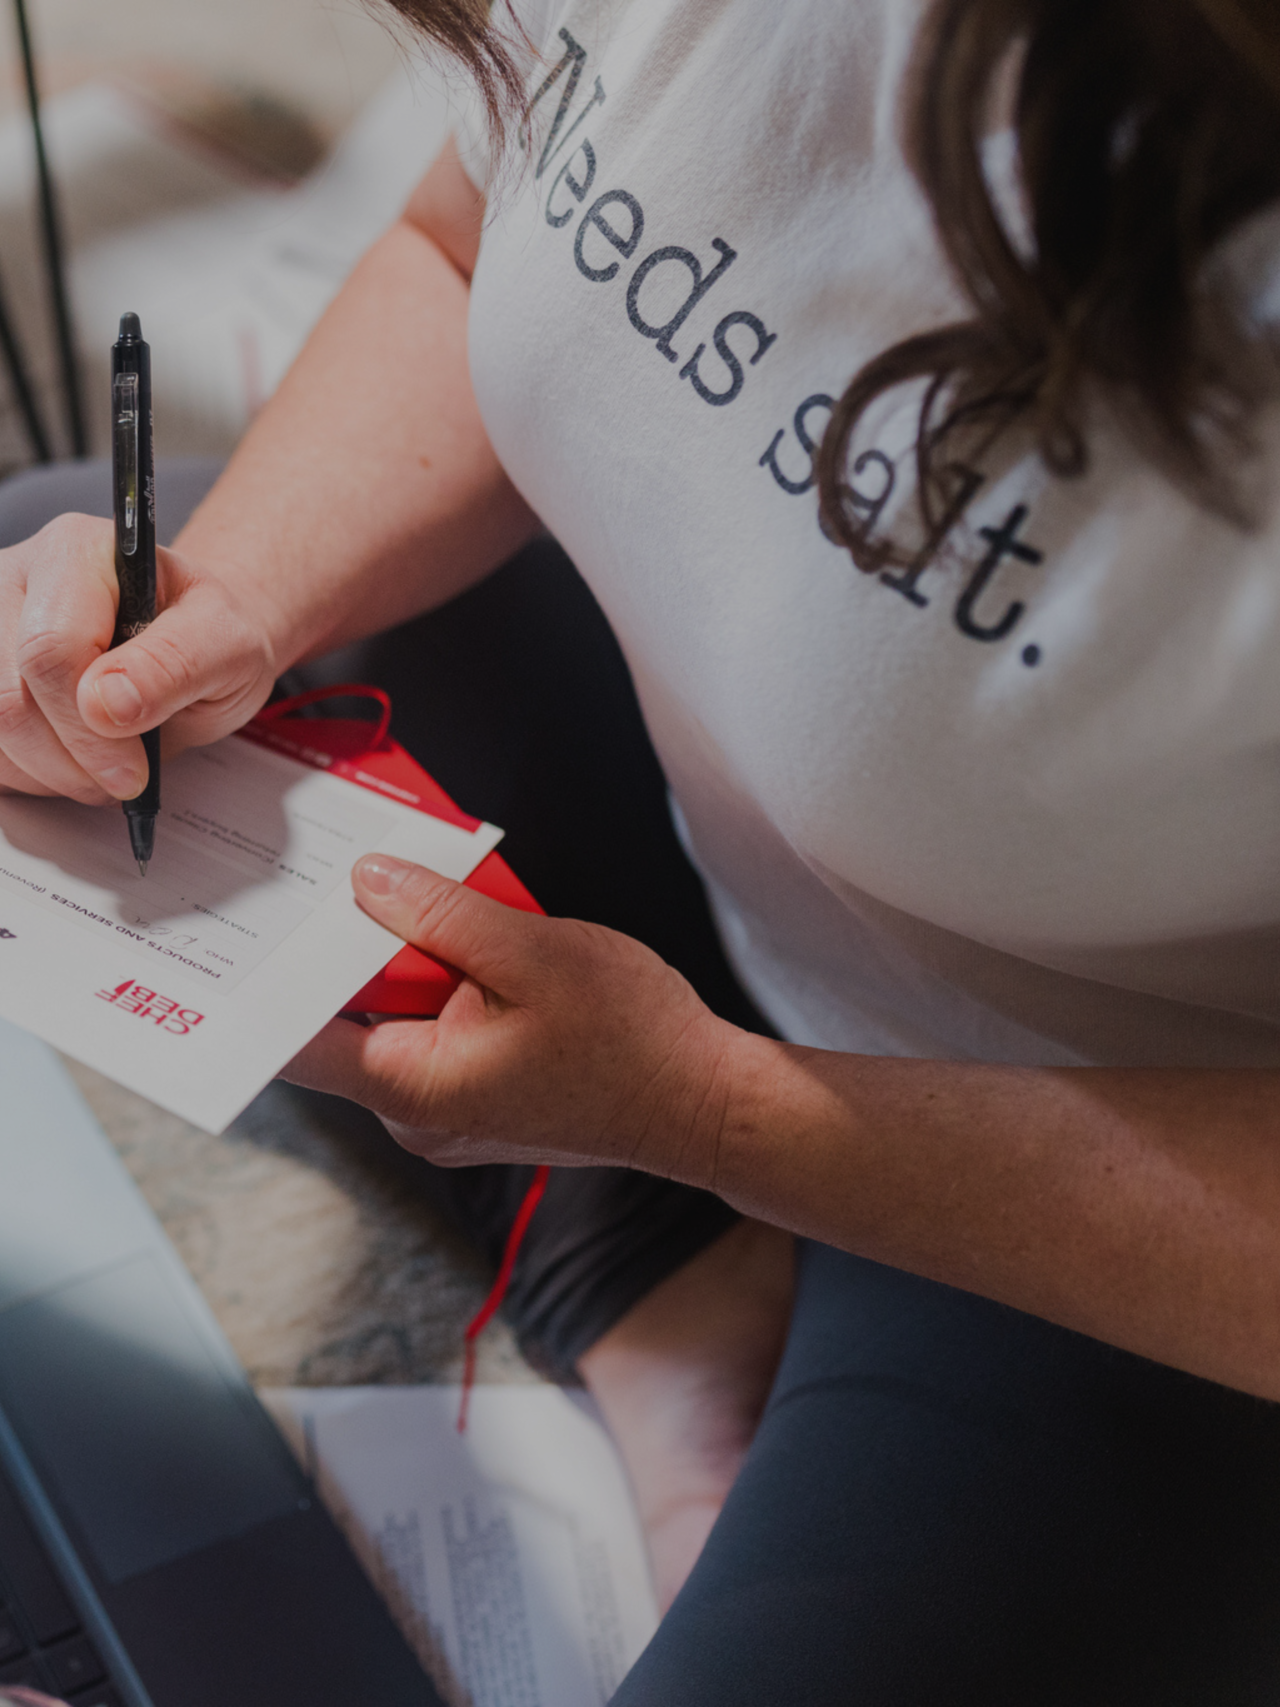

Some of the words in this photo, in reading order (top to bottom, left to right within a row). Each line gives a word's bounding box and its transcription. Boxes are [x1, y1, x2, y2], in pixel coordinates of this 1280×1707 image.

[519, 27, 778, 407] Needs
[50, 893, 115, 927] SERVICES
[115, 925, 146, 942] AND
[147, 940, 222, 979] PRODUCTS
[94, 988, 190, 1035] CHEF
